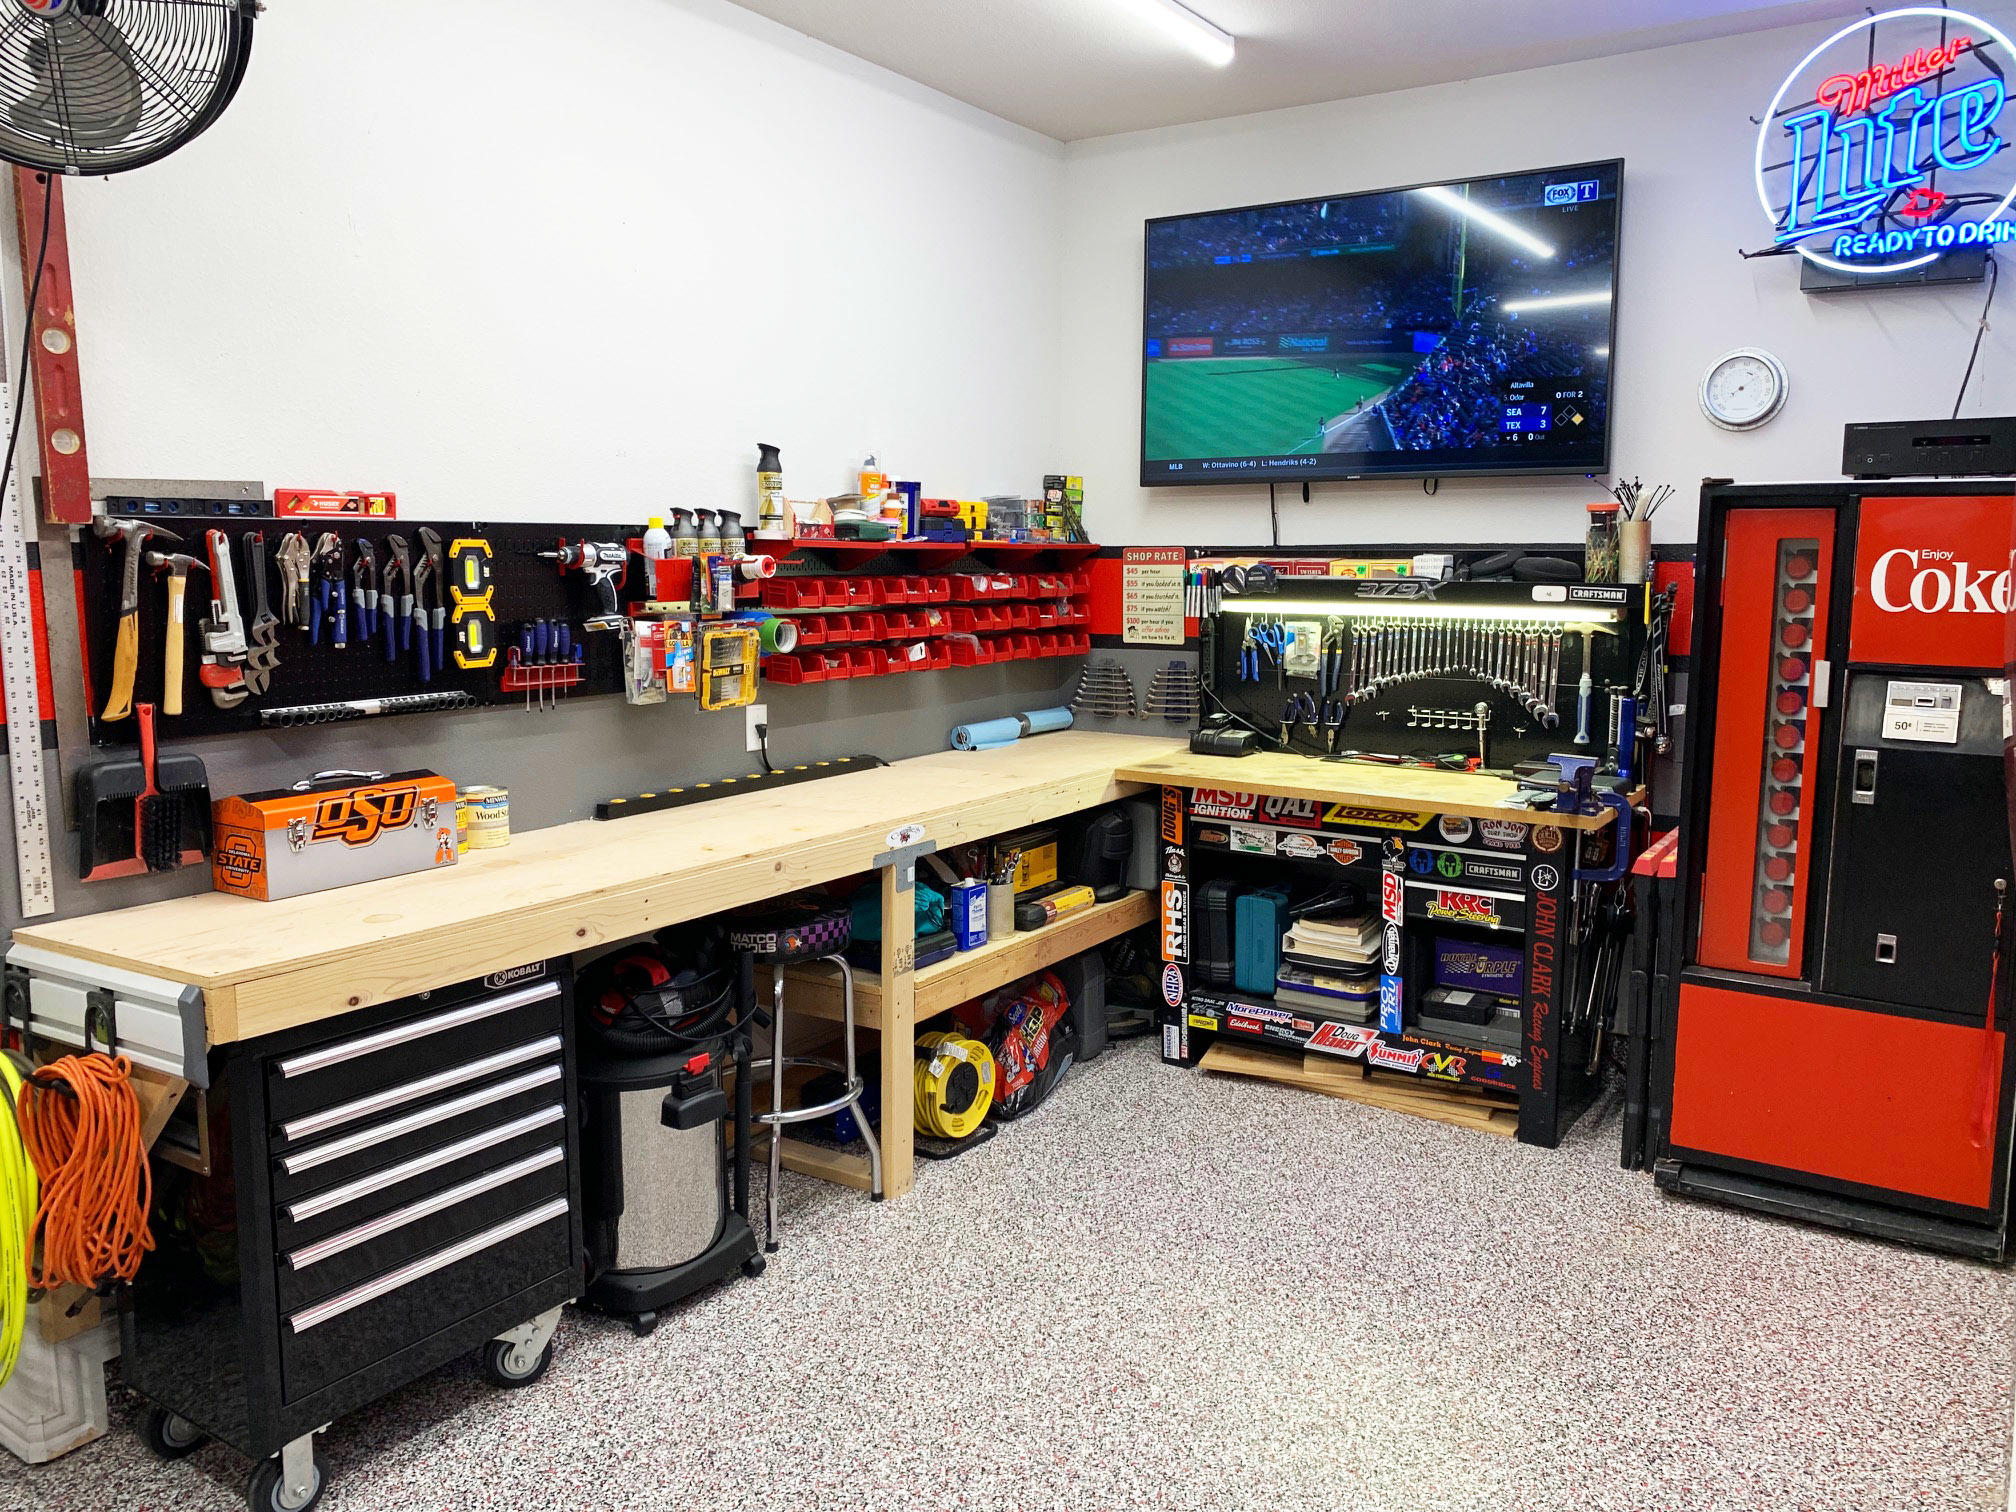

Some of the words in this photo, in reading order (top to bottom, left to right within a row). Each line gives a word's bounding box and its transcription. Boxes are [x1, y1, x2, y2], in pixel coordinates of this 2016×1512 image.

[1816, 36, 1972, 117] Miller
[1774, 77, 2005, 242] Lite
[1552, 188, 1570, 198] FOX
[1580, 182, 1594, 199] T
[1562, 204, 1580, 213] LIVE
[1834, 224, 1919, 258] READY
[1921, 224, 1955, 247] TO
[1510, 393, 1525, 401] Odor
[1506, 407, 1522, 416] SEA
[1540, 406, 1547, 415] 7
[1506, 421, 1521, 429] TEX
[1540, 420, 1546, 428] 3
[1512, 433, 1518, 441] 6
[1528, 433, 1534, 441] 0
[1211, 461, 1239, 469] Ottavino
[1239, 460, 1257, 469] (6-4)
[1268, 459, 1299, 467] Hendriks
[1299, 458, 1317, 467] (4-2)
[1126, 552, 1152, 561] SHOP
[1154, 551, 1182, 560] RATE:
[1921, 549, 1954, 560] Enjoy
[10, 592, 16, 602] IN
[1354, 581, 1448, 600] 379X
[1572, 589, 1624, 600] CRAFTSMAN
[1126, 604, 1138, 612] $75
[1126, 617, 1140, 625] $100
[1195, 787, 1255, 808] MSD
[476, 810, 500, 820] Wood
[1162, 787, 1177, 839] DOUG'S
[1194, 803, 1250, 819] IGNITION
[1264, 795, 1316, 820] QA1
[311, 787, 421, 848] OSU
[1339, 805, 1420, 827] LOKAR
[1482, 820, 1503, 831] RON
[1504, 820, 1524, 833] JON
[1486, 829, 1500, 837] SURF
[228, 849, 250, 857] OKLAHOMA
[218, 853, 260, 870] STATE
[225, 865, 250, 874] UNIVERSITY
[1468, 865, 1519, 878] CRAFTSMAN
[1384, 870, 1397, 921] MSD
[1439, 890, 1494, 916] KRC
[1427, 902, 1457, 918] Power
[1456, 908, 1500, 928] Steering
[1535, 892, 1557, 941] JOHN
[1166, 888, 1184, 960] RHS
[730, 932, 777, 944] MATCO
[730, 941, 777, 953] TOOLS
[1385, 930, 1398, 967] Dynamat
[508, 963, 540, 980] KOBALT
[1468, 957, 1518, 973] PURPLE
[1531, 942, 1555, 999] CLARK
[1165, 969, 1179, 1000] NHRA
[1387, 979, 1396, 1013] TRU
[1380, 988, 1388, 1029] PRO
[1229, 1018, 1260, 1032] Edelbrock
[1264, 1024, 1295, 1036] ENERGY
[1526, 1002, 1549, 1042] Racing
[1332, 1026, 1360, 1041] DOUG
[1402, 1034, 1419, 1044] John
[1420, 1037, 1442, 1049] Clark
[1370, 1042, 1421, 1066] SUMMIT
[1420, 1052, 1467, 1077] CVR
[1527, 1045, 1550, 1090] Engines
[1470, 1076, 1517, 1090] GOODRIDGE
